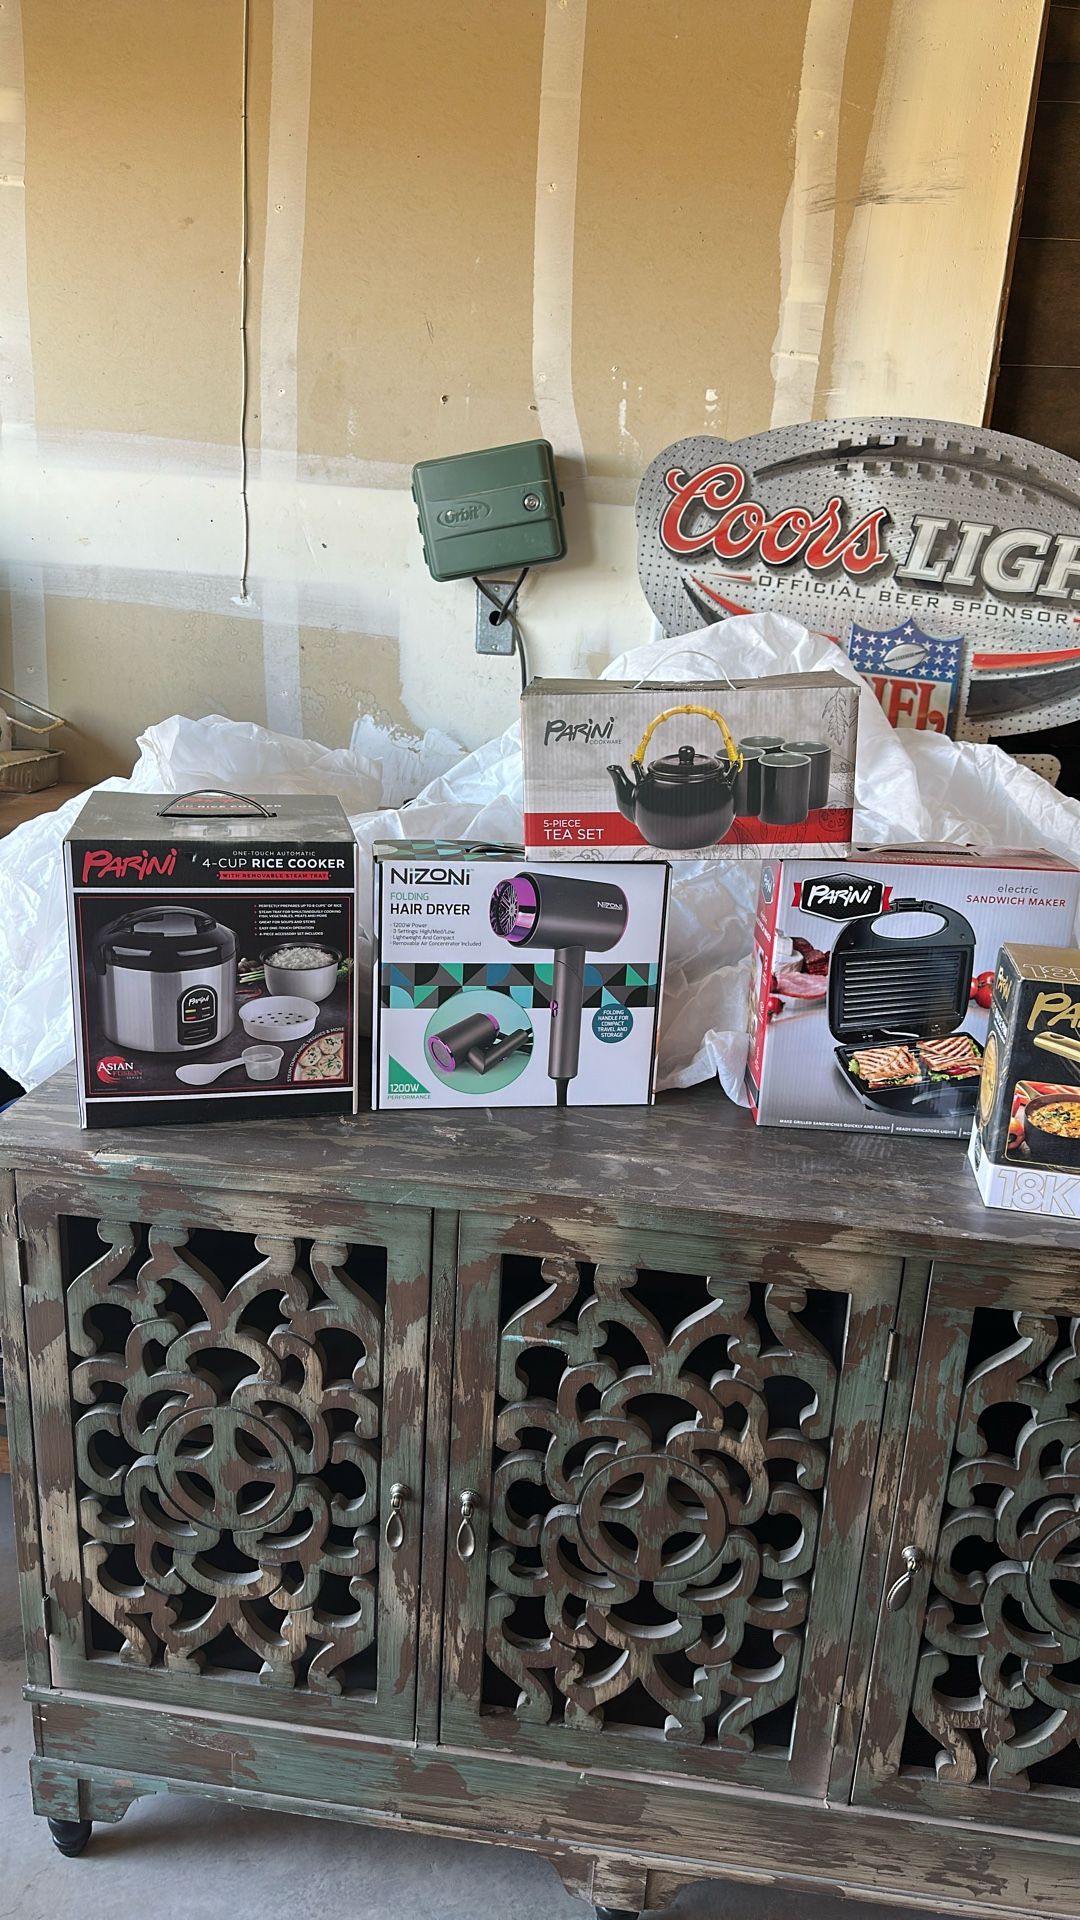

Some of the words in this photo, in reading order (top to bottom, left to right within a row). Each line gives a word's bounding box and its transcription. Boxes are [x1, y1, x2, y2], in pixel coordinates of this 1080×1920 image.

[445, 505, 479, 523] Orbit
[660, 463, 889, 576] Coors
[759, 575, 866, 599] OFFICIAL
[879, 591, 939, 608] BEER
[952, 600, 1067, 624] SPONSOR
[543, 819, 581, 828] 5-PIECE
[544, 829, 573, 840] TEA
[578, 829, 605, 840] SET
[202, 858, 247, 869] 4-CUP
[251, 858, 284, 869] RICE
[287, 858, 345, 869] COOKER
[997, 884, 1039, 894] electric
[390, 892, 429, 901] FOLDING
[966, 895, 1025, 905] SANDWICH
[1028, 898, 1066, 907] MAKER
[390, 903, 422, 915] HAIR
[426, 903, 470, 915] DRYER
[97, 1062, 134, 1075] ASIAN
[390, 1083, 419, 1093] 1200W
[999, 1168, 1080, 1216] 18K
